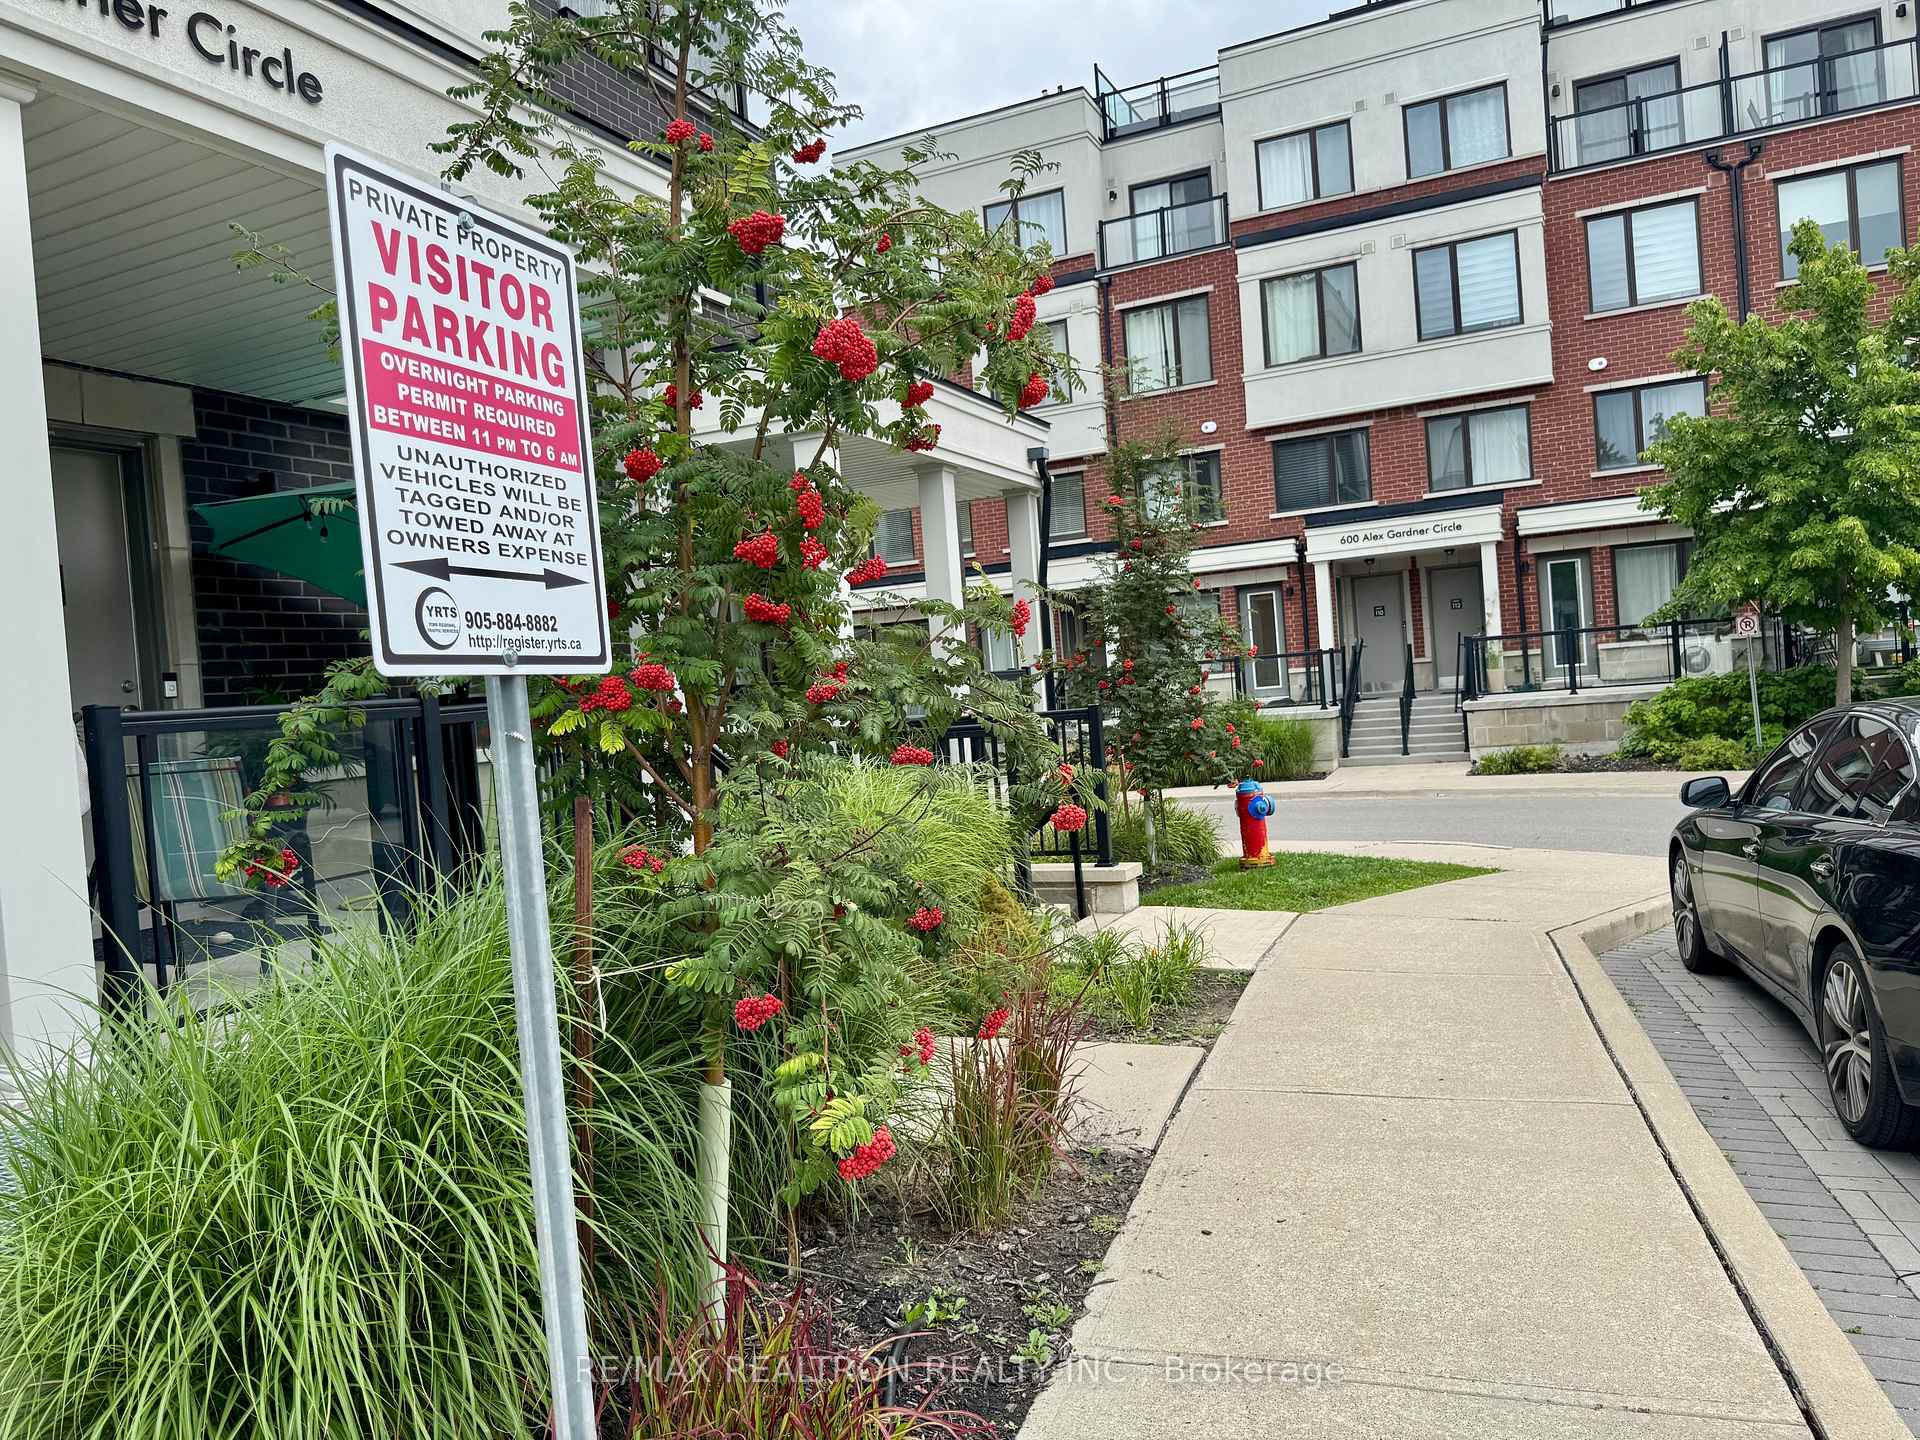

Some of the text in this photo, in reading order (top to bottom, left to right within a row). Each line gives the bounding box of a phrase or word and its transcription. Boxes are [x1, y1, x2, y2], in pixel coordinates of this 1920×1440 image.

[187, 11, 323, 104] Circle
[349, 178, 562, 285] PRIVATE PROPERTY
[371, 220, 554, 332] VISITOR
[368, 281, 566, 389] PARKING
[380, 352, 565, 417] OVERNIGHT PARKING
[397, 383, 556, 437] PERMIT REQUIRED
[373, 404, 577, 466] BETWEEN 11 PM TO 6 AM
[380, 463, 582, 512] VEHICLES WILL BE
[397, 445, 567, 491] UNAUTHORIZED
[395, 487, 575, 529] TAGGED AND/OR
[399, 509, 575, 547] TOWED AWAY AT
[387, 529, 588, 567] OWNERS EXPENSE
[1340, 521, 1462, 545] 600 Alex Gardner Circle
[426, 605, 457, 618] YRTS
[464, 611, 558, 632] 905-884-8882
[468, 633, 582, 652] http://register.yrts.ca
